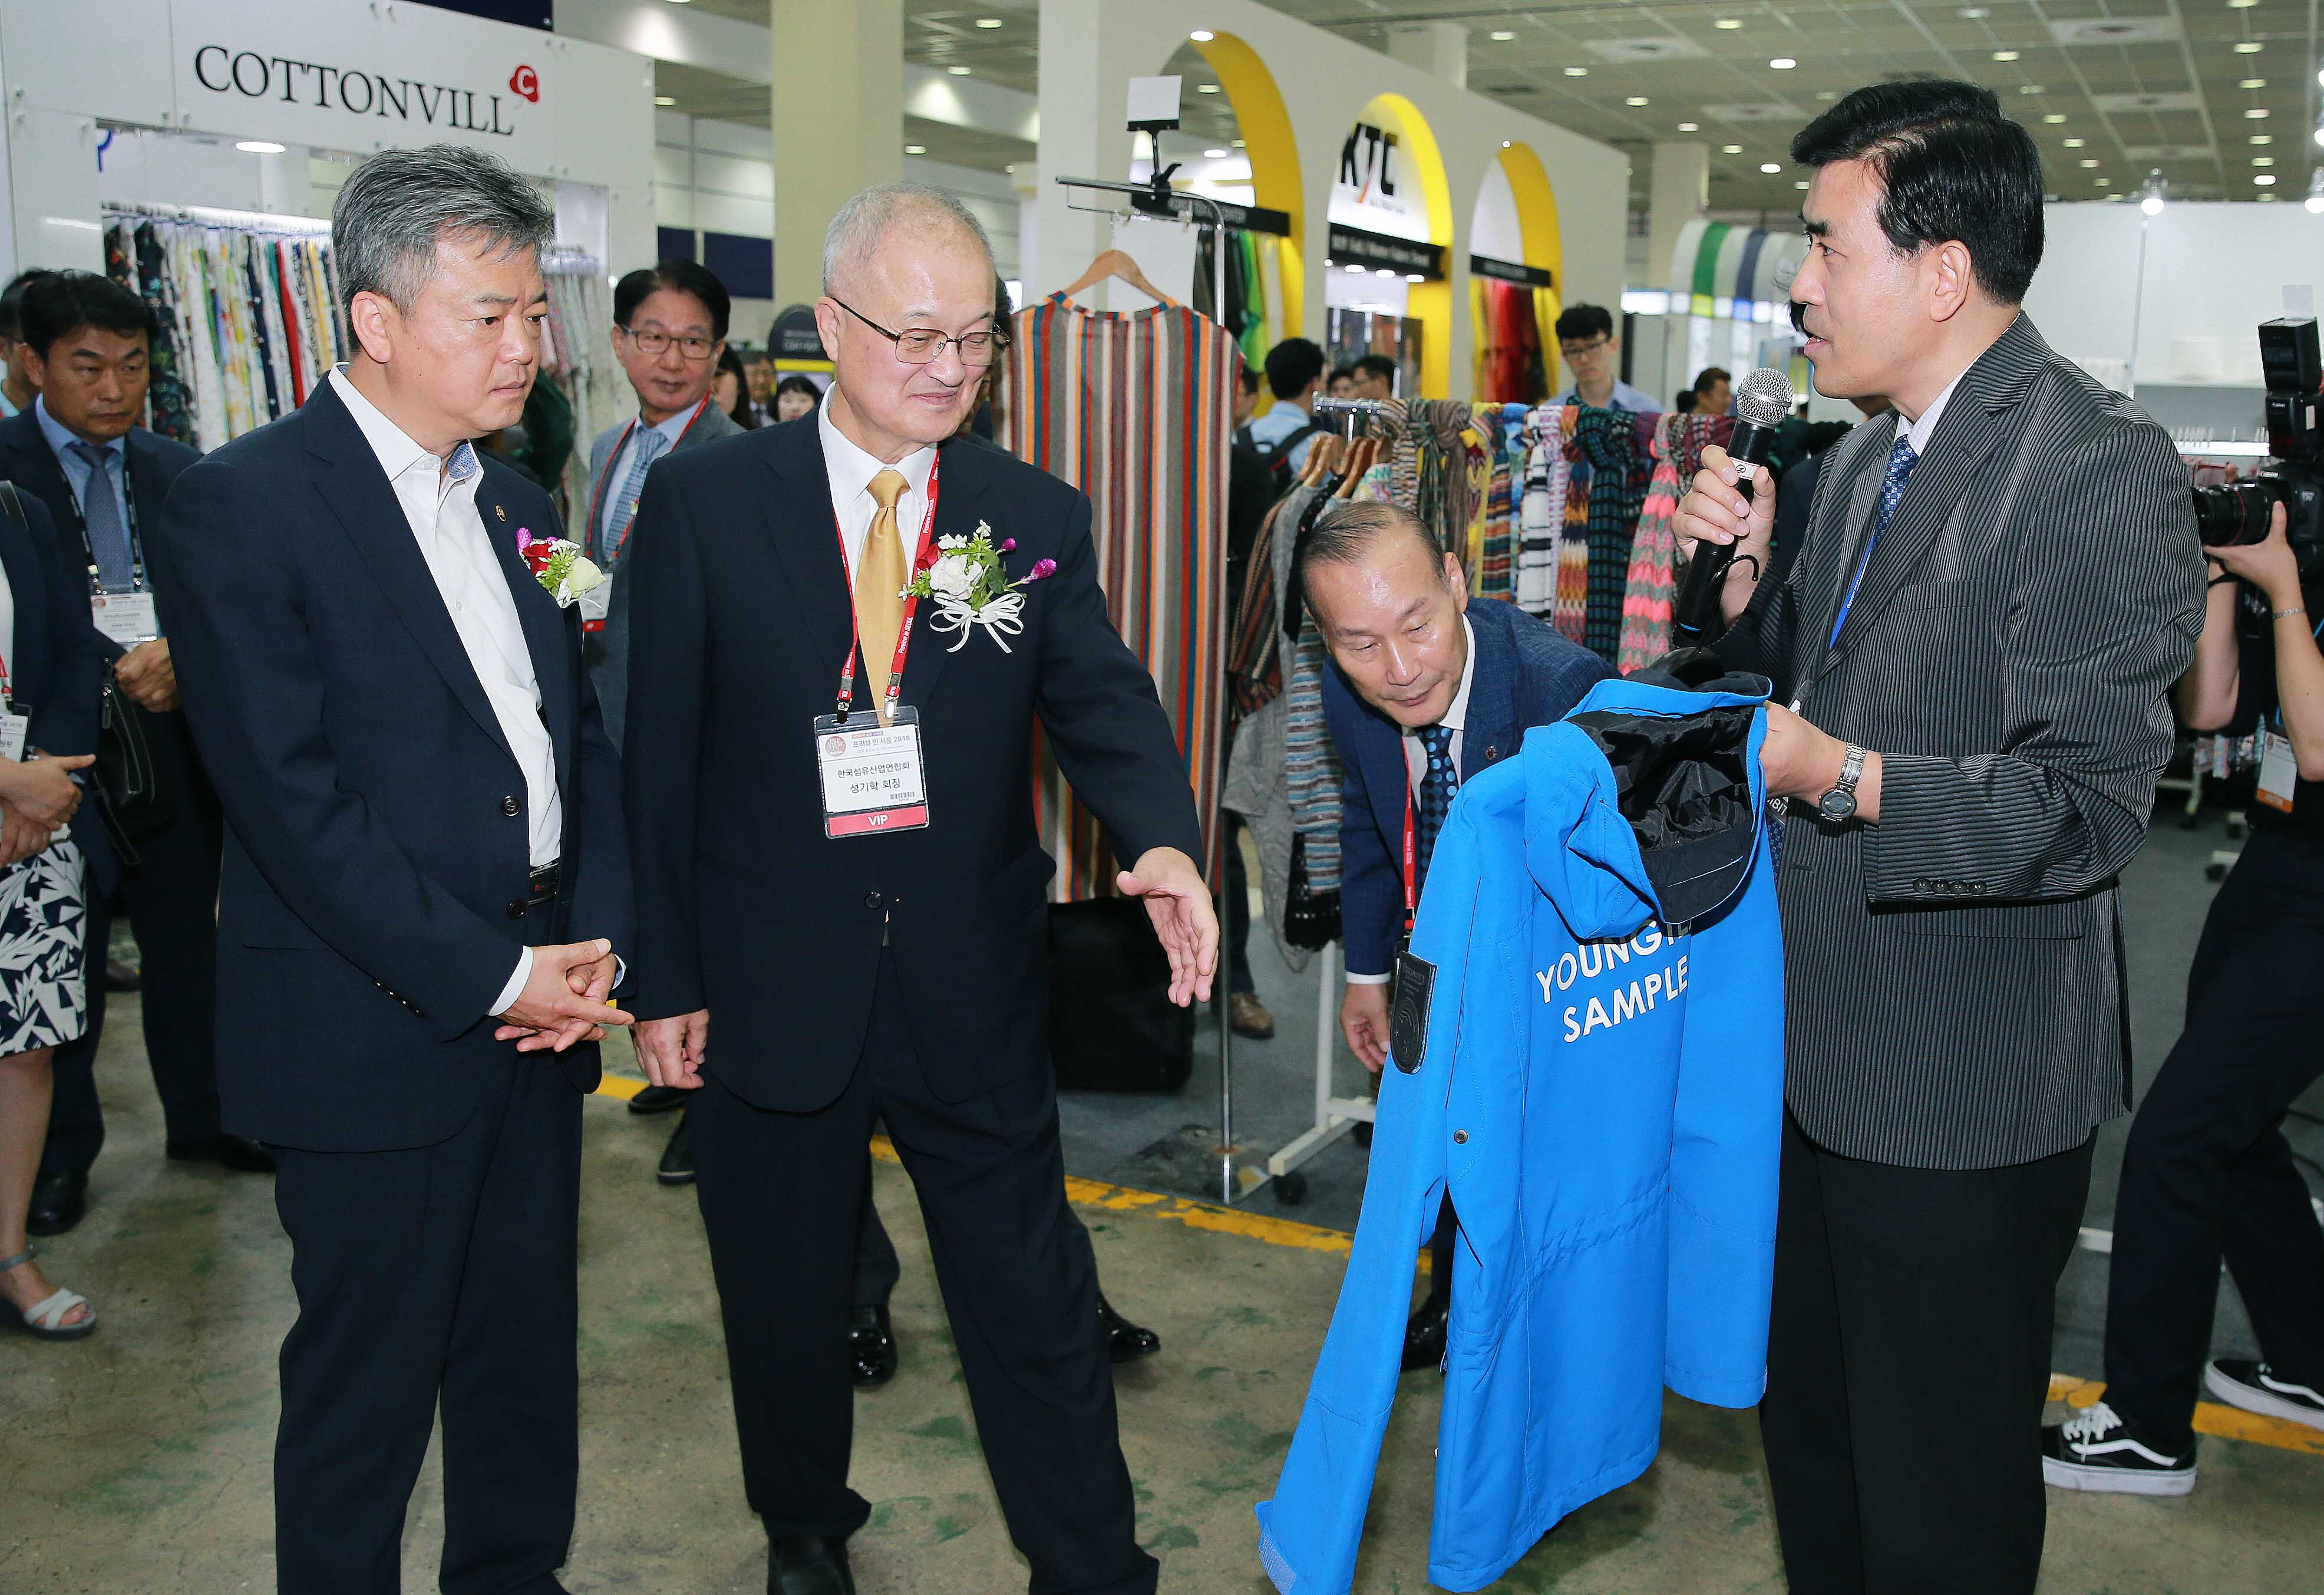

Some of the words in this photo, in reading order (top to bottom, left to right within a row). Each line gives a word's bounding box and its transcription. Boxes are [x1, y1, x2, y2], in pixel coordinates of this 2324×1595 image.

[194, 45, 514, 136] COTTONVILL
[1340, 123, 1398, 203] KTC
[899, 635, 907, 654] Preview
[905, 617, 913, 631] SEOUL
[880, 737, 892, 746] 서울
[837, 761, 910, 779] 한국섬유산업연합회
[850, 781, 879, 794] 성기학
[883, 778, 901, 790] 회장
[867, 815, 889, 826] VIP
[1563, 954, 1688, 1043] SAMPLE
